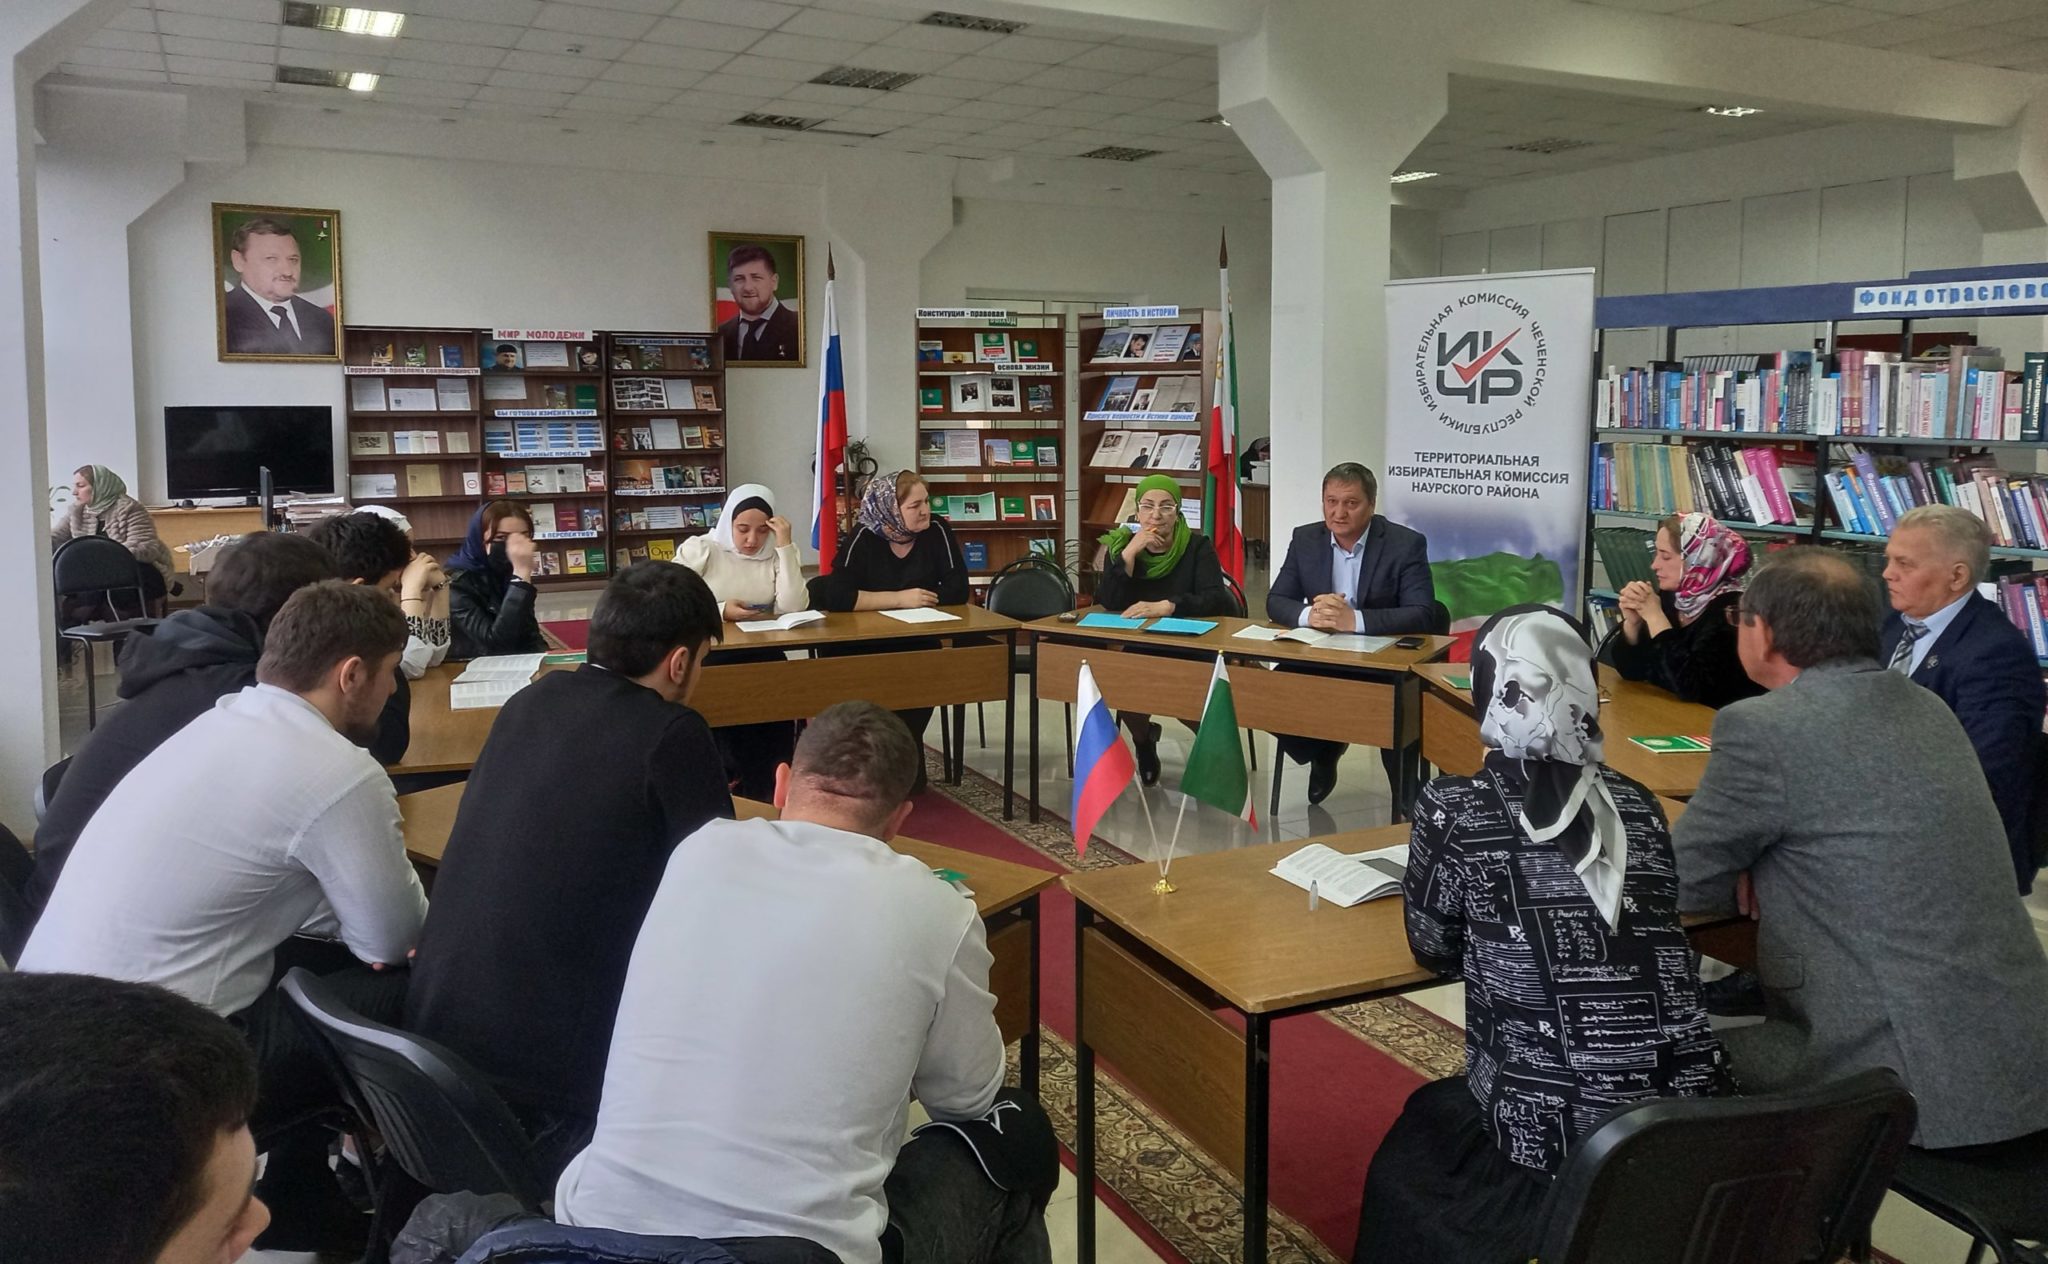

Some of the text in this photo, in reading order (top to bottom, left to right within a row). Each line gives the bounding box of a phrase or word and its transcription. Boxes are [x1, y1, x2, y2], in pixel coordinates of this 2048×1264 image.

[917, 309, 965, 318] Конституция
[970, 310, 1005, 318] правовая
[1105, 308, 1139, 318] ЛИЧНОСТЬ
[497, 330, 585, 340] МИР МОЛОДЕЖИ
[1416, 292, 1548, 435] ИЗБИРАТЕЛЬНАЯ КОМИССИЯ ЧЕЧЕНСКОЙ РЕСПУБЛИКИ
[1414, 451, 1540, 467] ТЕРРИТОРИАЛЬНАЯ
[1388, 465, 1569, 485] ИЗБИРАТЕЛЬНАЯ КОМИССИЯ
[1411, 481, 1540, 499] НАУРСКОГО РАЙОНА
[1506, 925, 1528, 943] Rx
[1538, 1020, 1557, 1039] Rx
